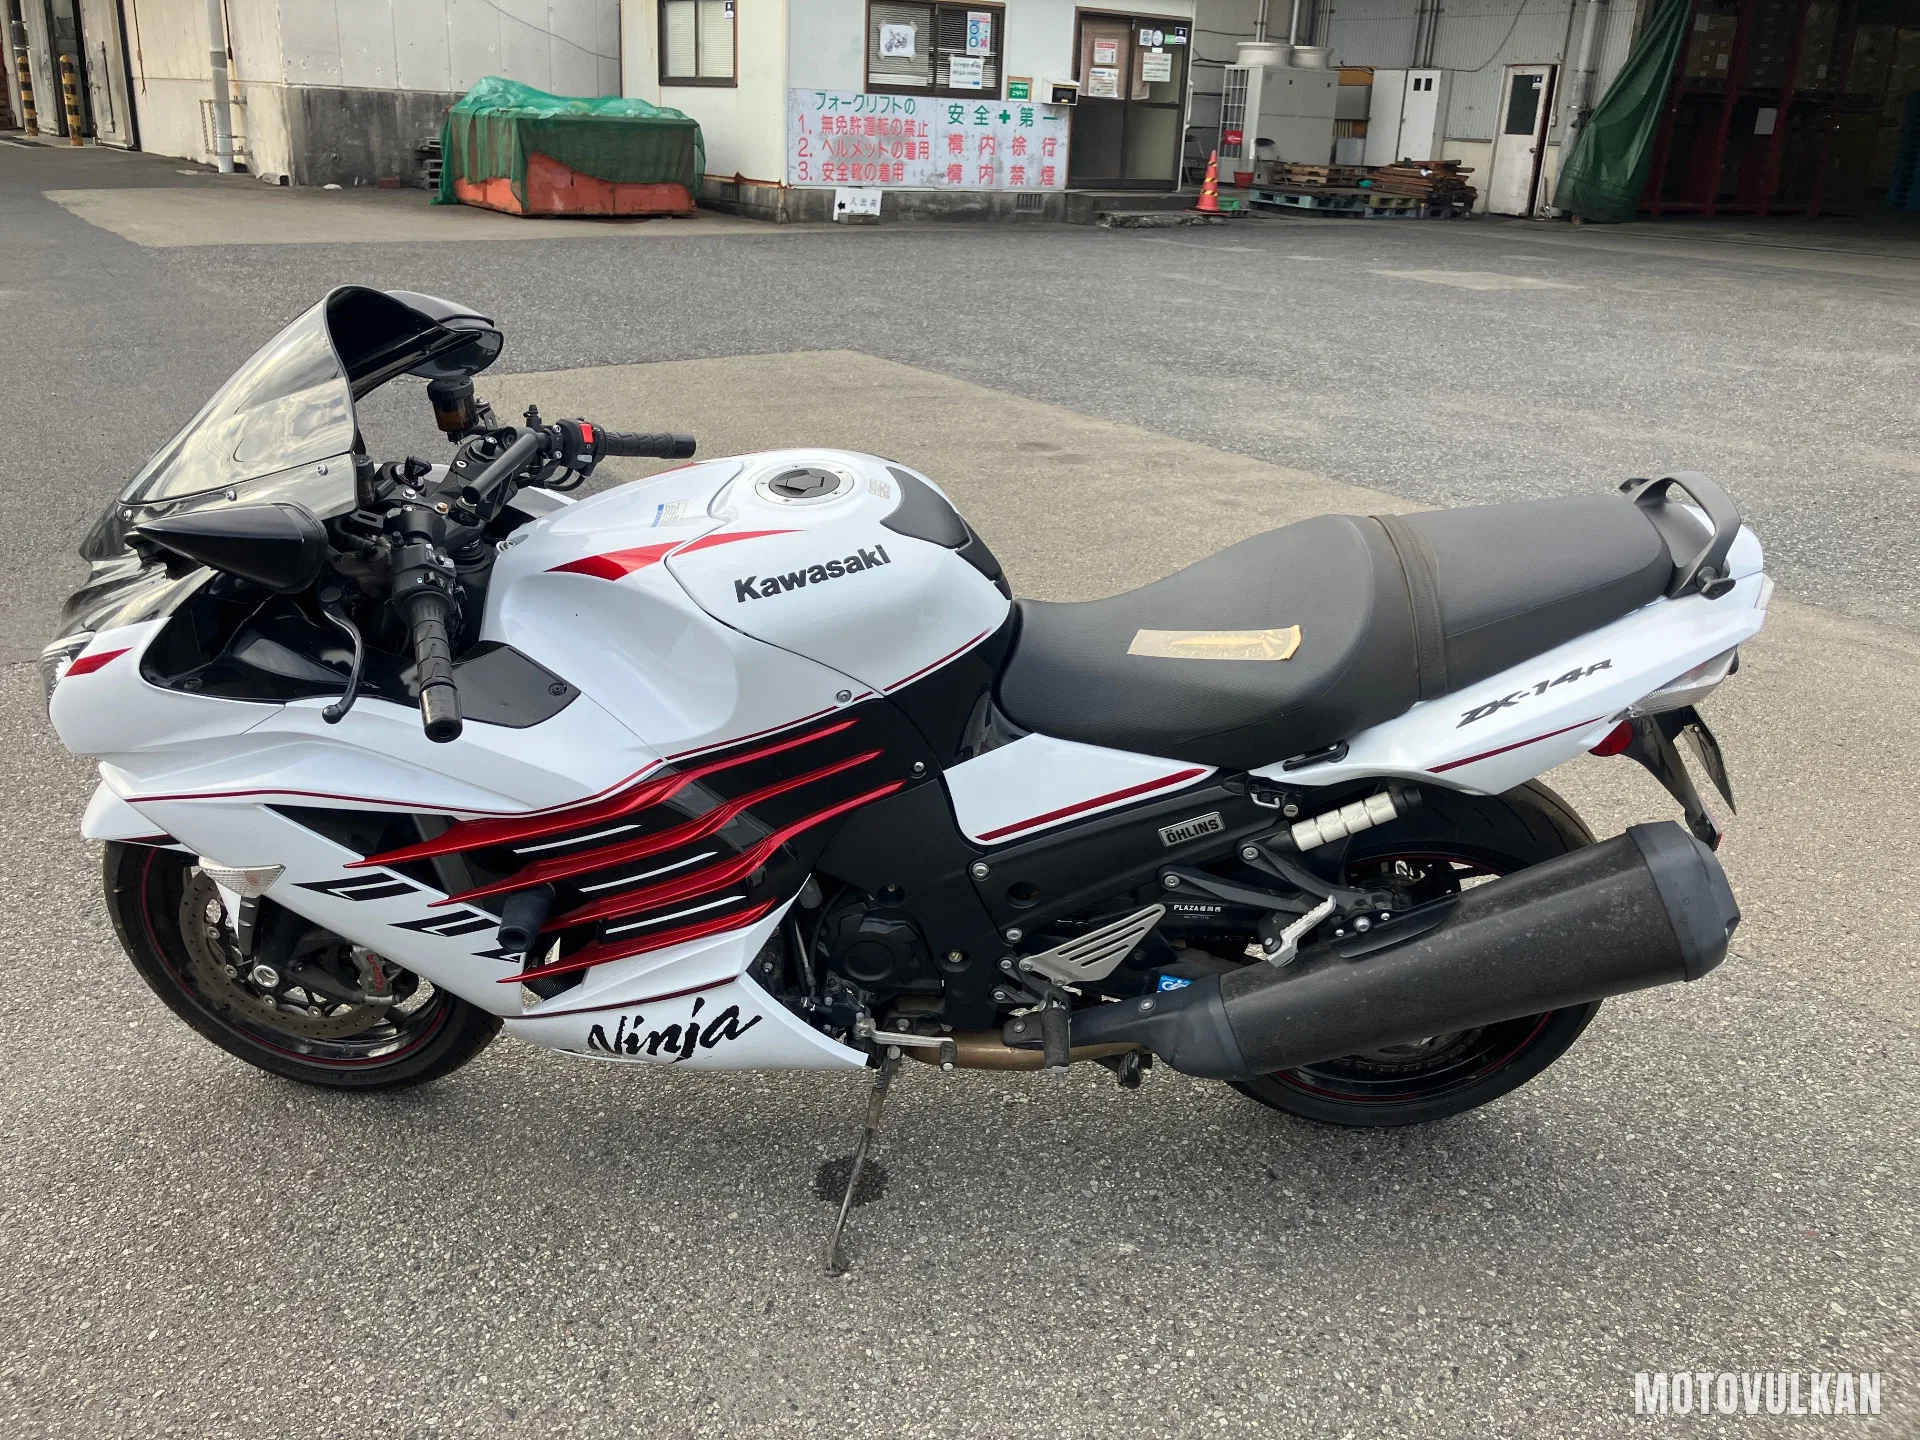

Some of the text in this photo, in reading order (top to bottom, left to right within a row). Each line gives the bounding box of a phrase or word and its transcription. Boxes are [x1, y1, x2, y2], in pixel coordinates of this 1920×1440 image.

[815, 92, 916, 115] フォークリフトの
[948, 103, 1058, 128] 安全 第一
[797, 114, 929, 138] 1. 無免許運転の禁止
[797, 137, 930, 160] 2. ヘルメットの着用
[947, 133, 1057, 158] 構内徐行
[797, 160, 905, 183] 3. 安全靴の着用
[734, 544, 892, 603] Kawasaki
[1455, 658, 1613, 730] ZX-14R
[1165, 819, 1219, 843] ÖHLINS
[588, 996, 763, 1064] Ninja
